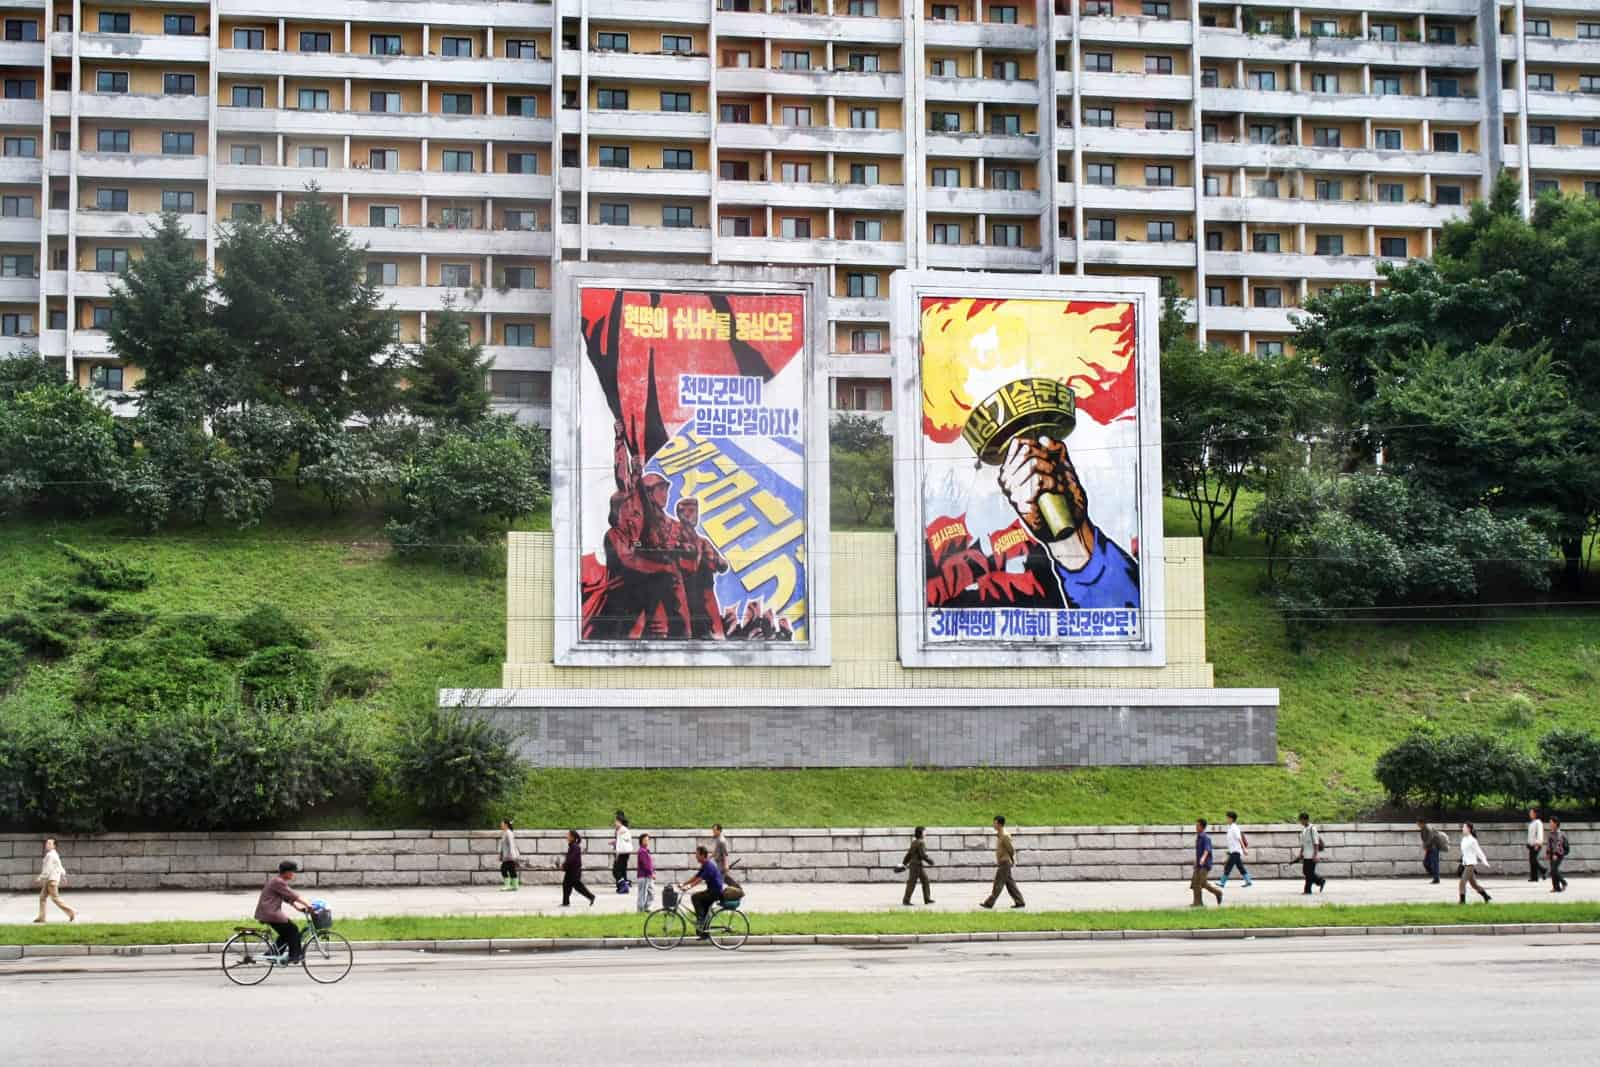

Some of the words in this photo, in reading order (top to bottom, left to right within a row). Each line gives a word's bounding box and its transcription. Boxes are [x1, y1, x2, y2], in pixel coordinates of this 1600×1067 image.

[623, 304, 668, 338] 혁명의
[673, 306, 731, 341] 수뇌부를
[735, 311, 793, 341] 중심으로
[681, 376, 761, 405] 천만군민이
[696, 407, 799, 435] 일심단결하자!
[931, 609, 995, 636] 3대혁명의
[1000, 608, 1050, 636] 기치높이
[1056, 610, 1137, 637] 총진군앞으로!
